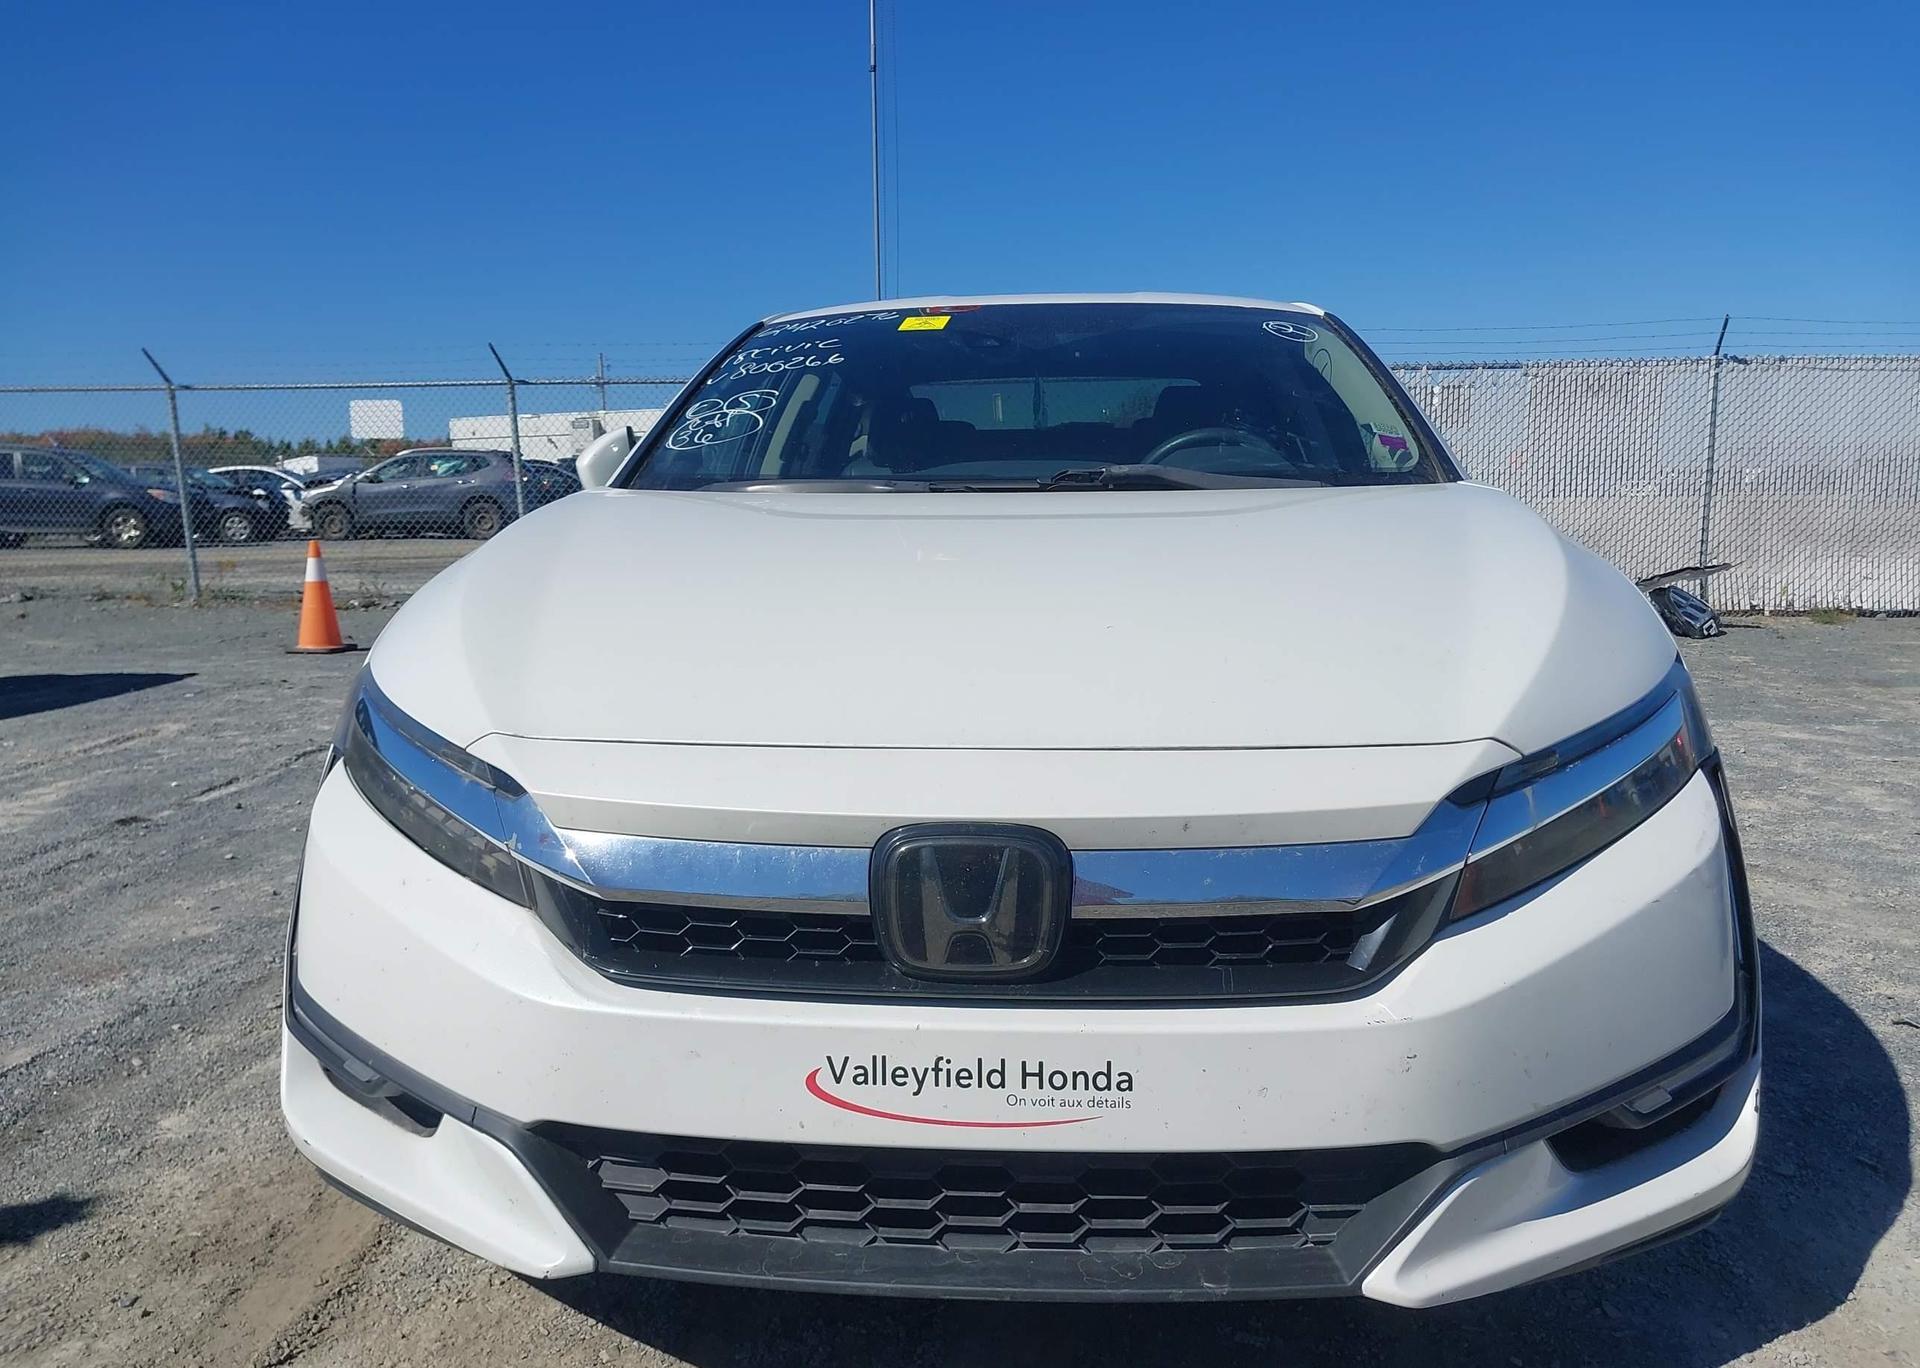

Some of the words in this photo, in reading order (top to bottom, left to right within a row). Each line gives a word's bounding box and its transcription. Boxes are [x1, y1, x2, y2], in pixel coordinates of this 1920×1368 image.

[826, 1054, 1006, 1097] Valleyfield
[1021, 1060, 1134, 1093] Honda
[1006, 1093, 1027, 1107] On
[1031, 1095, 1056, 1108] voit
[1059, 1098, 1083, 1108] aux
[1087, 1095, 1132, 1109] détails
